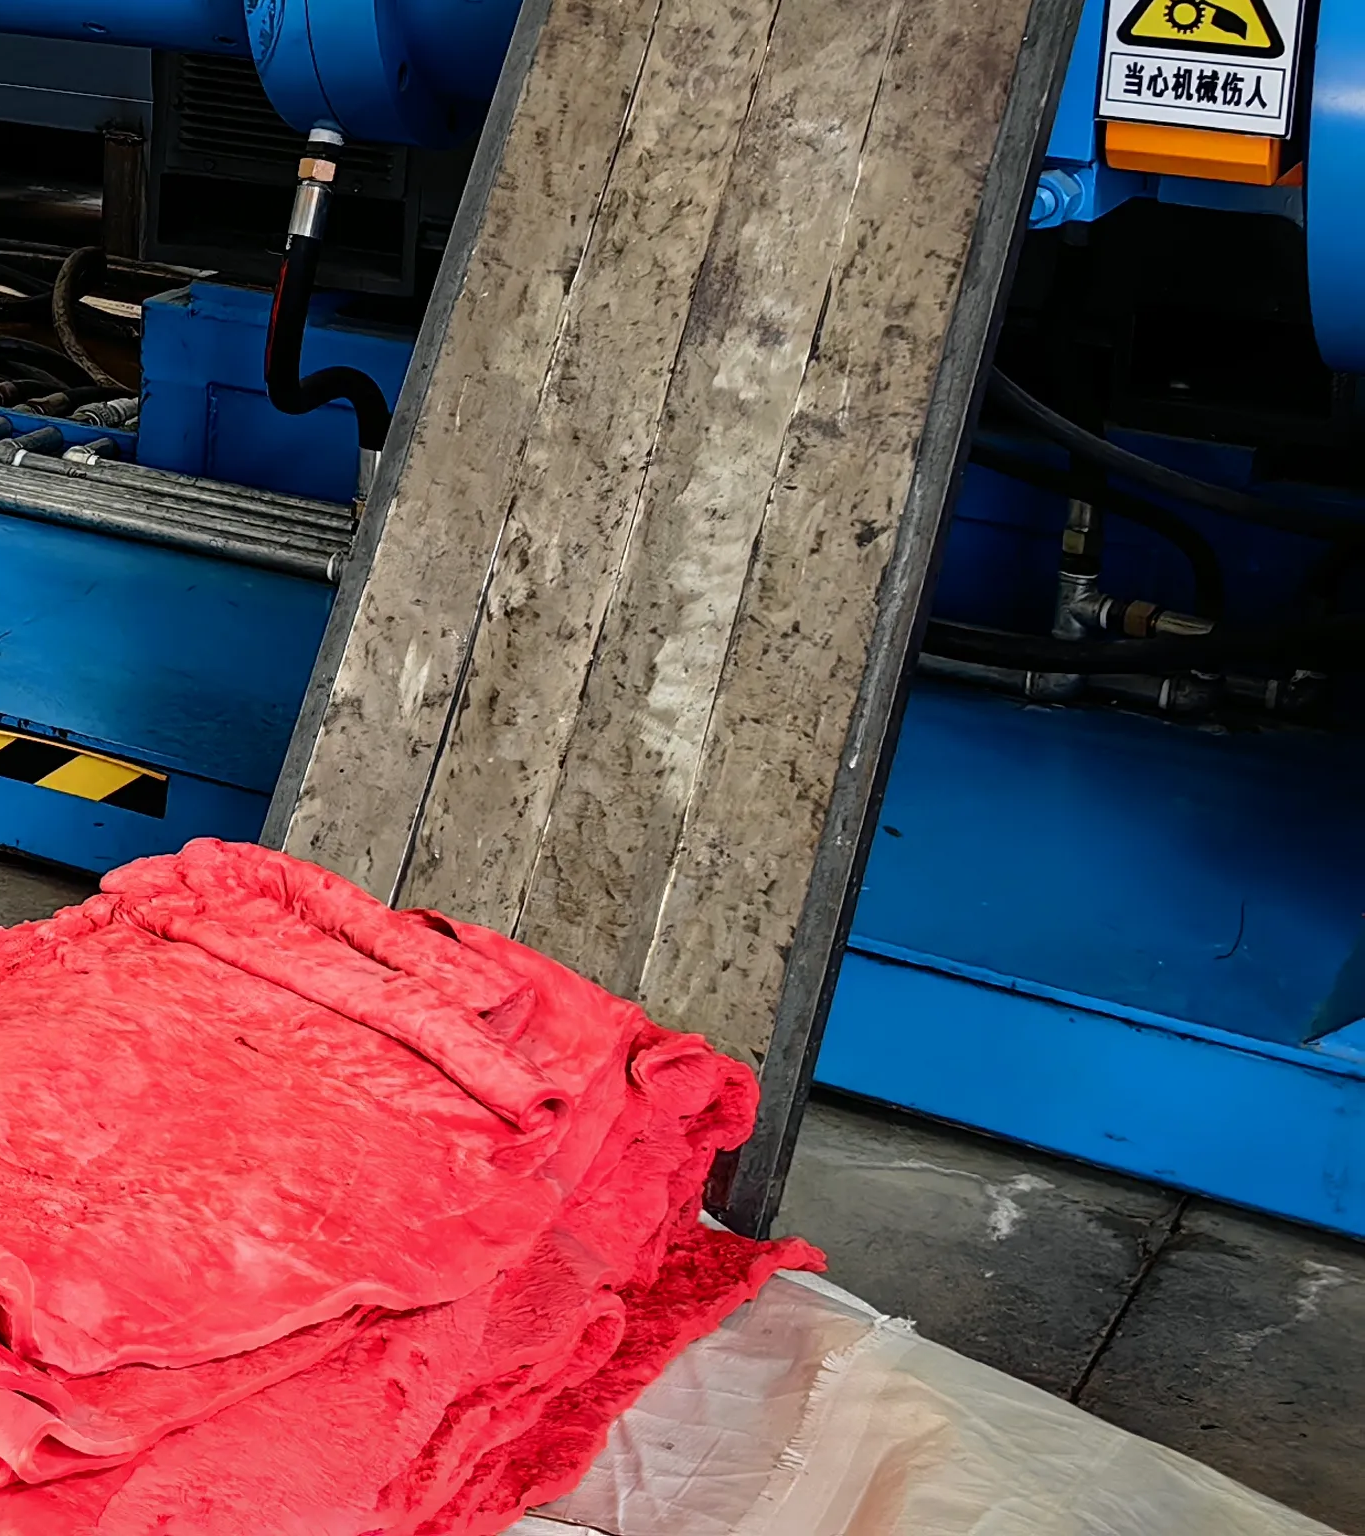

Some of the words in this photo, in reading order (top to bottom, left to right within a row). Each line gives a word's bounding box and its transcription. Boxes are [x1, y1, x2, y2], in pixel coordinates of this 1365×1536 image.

[1122, 62, 1268, 109] 当心机械伤人
